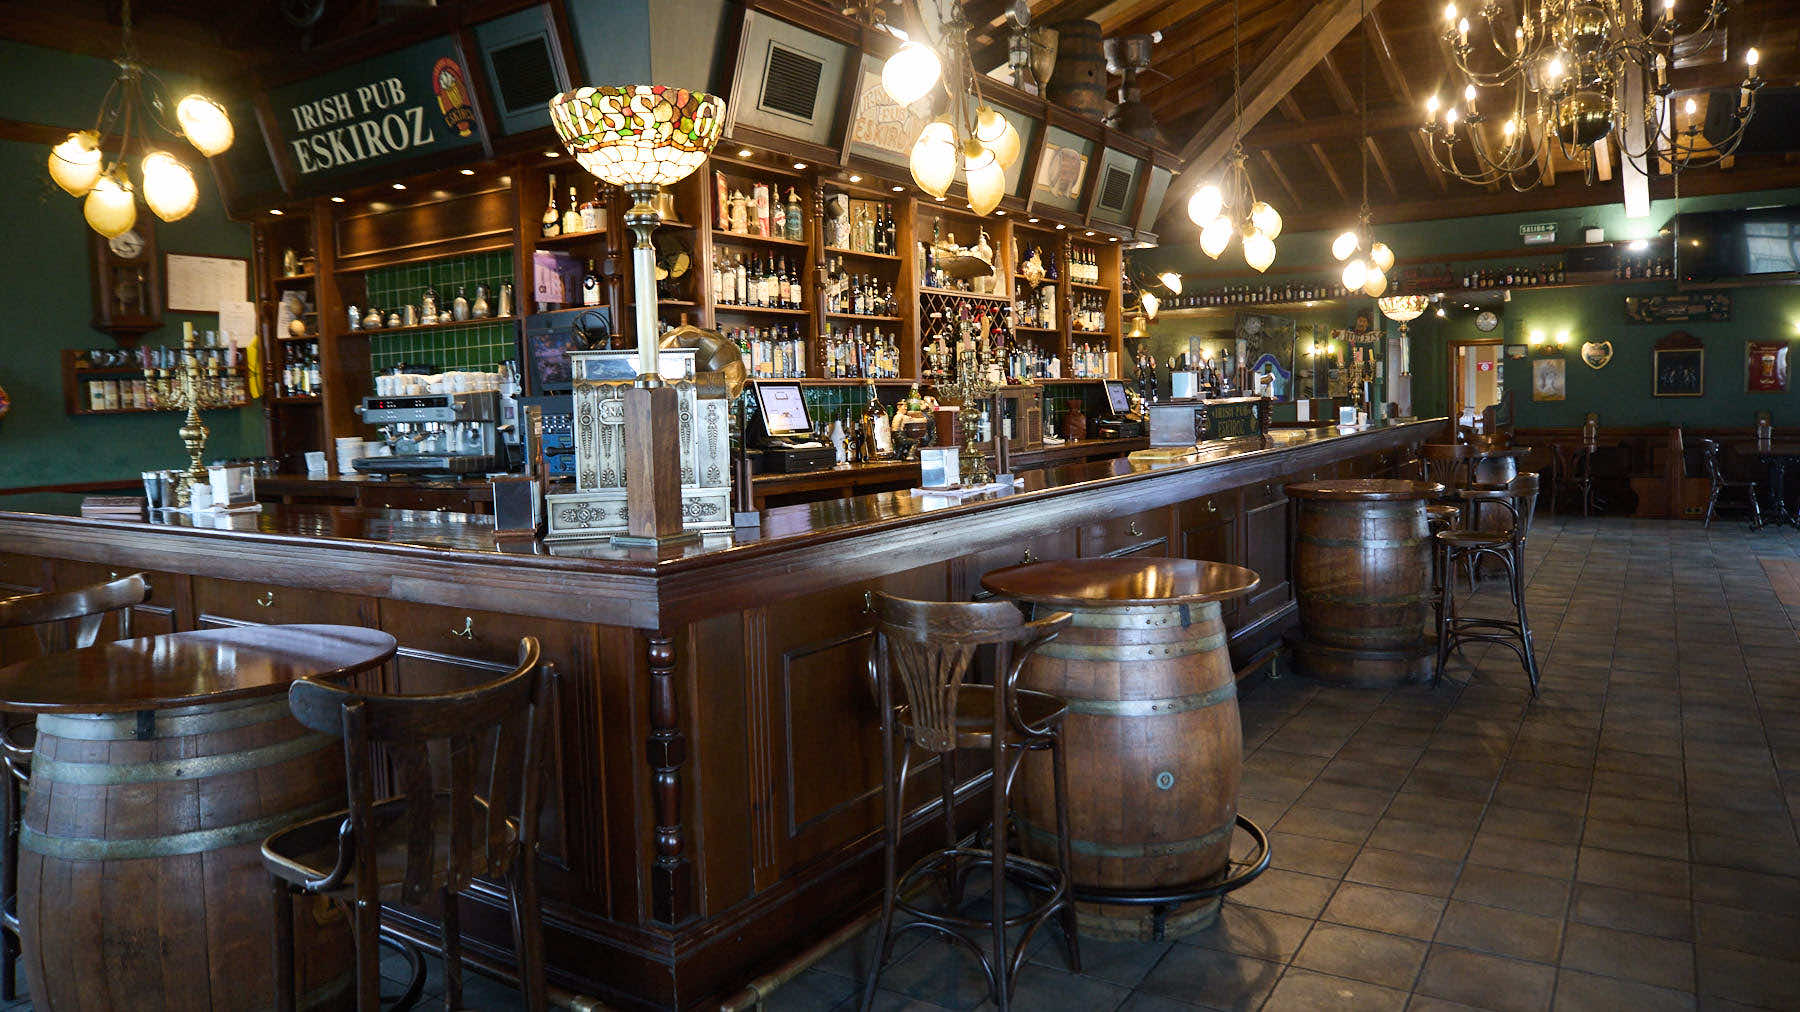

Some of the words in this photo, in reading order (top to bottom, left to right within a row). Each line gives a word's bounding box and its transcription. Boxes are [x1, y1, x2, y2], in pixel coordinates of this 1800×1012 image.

[291, 92, 354, 132] IRISH
[356, 76, 407, 114] PUB
[290, 105, 435, 174] ESKIROZ
